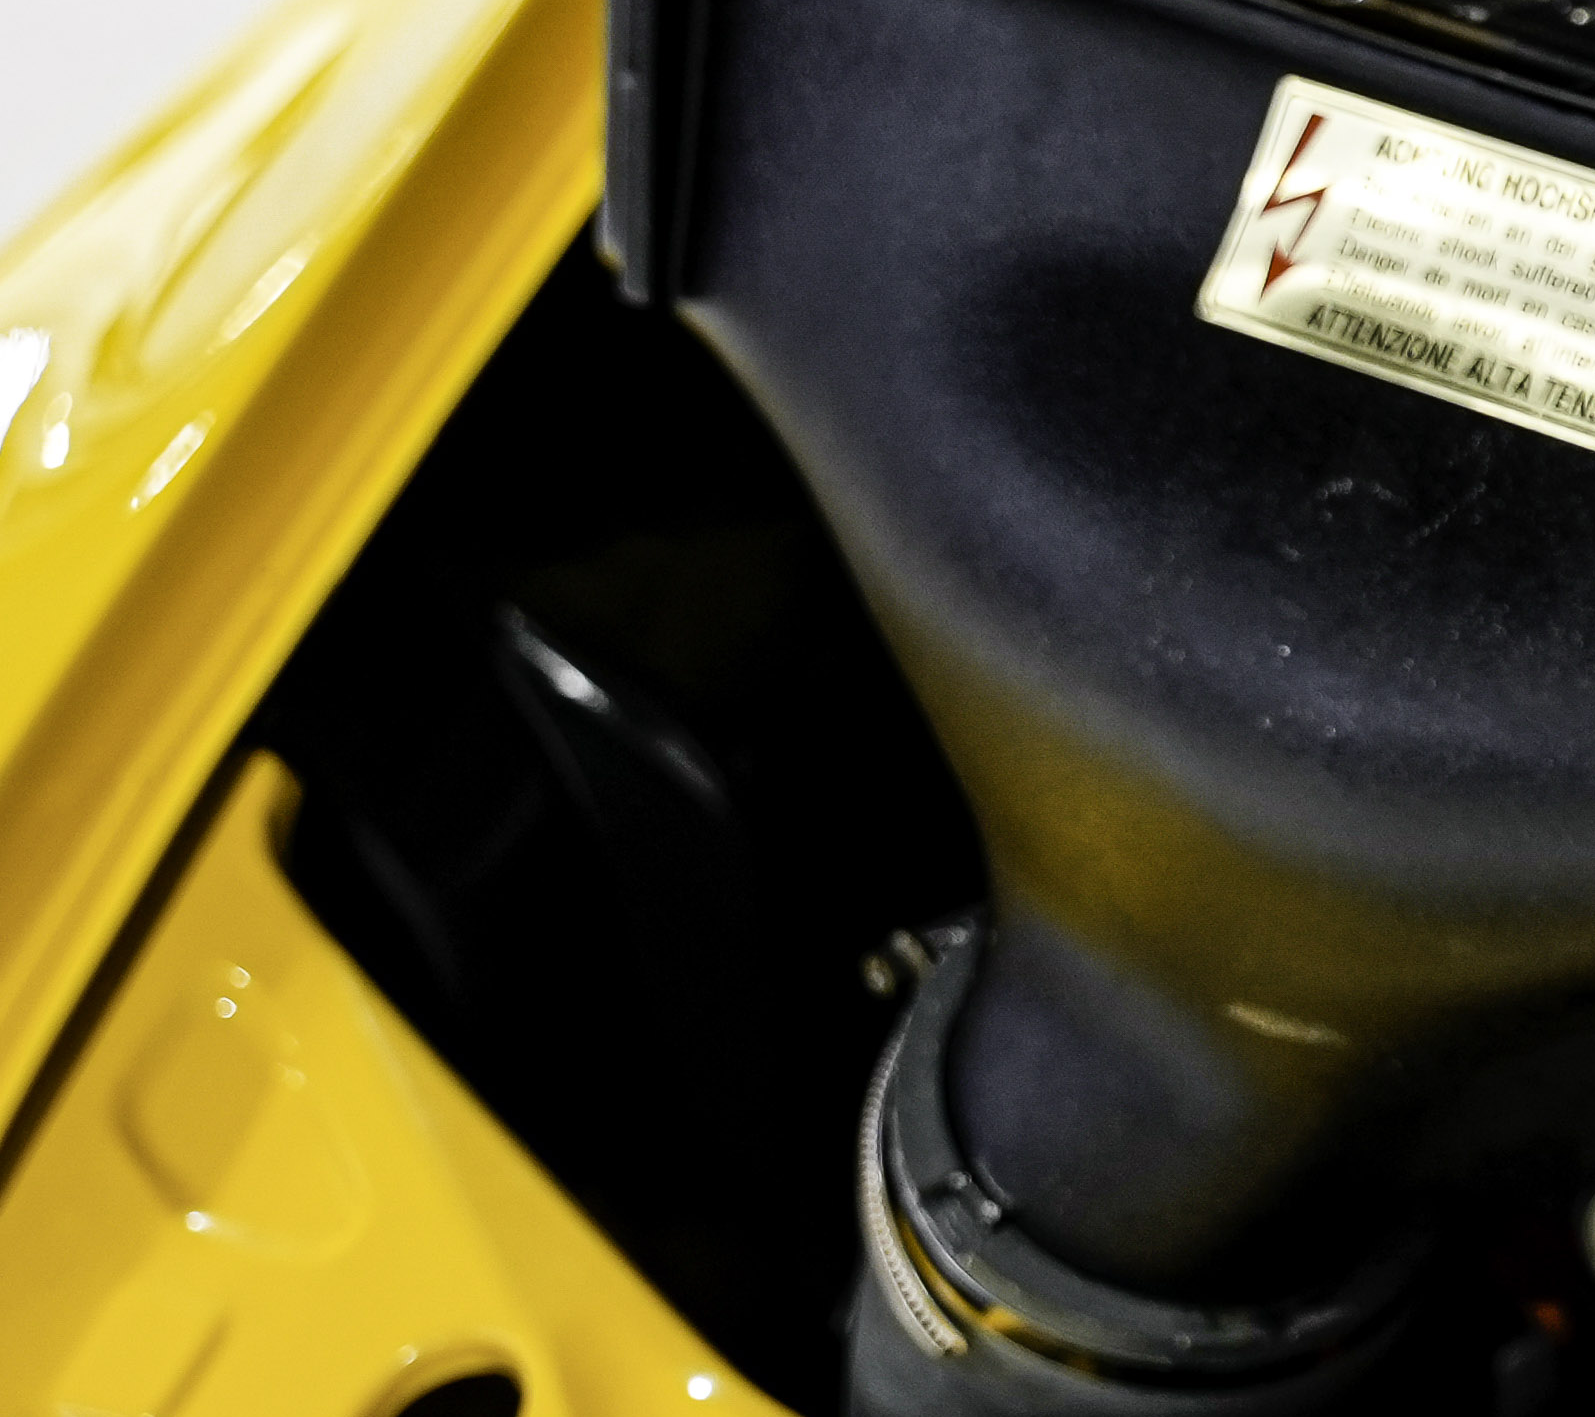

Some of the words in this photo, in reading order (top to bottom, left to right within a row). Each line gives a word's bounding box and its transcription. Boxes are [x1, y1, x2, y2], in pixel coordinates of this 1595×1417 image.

[1375, 130, 1497, 192] ACUNG
[1437, 233, 1502, 272] shock
[1305, 300, 1461, 375] ATTENZIONE
[1464, 353, 1537, 401] ALTA
